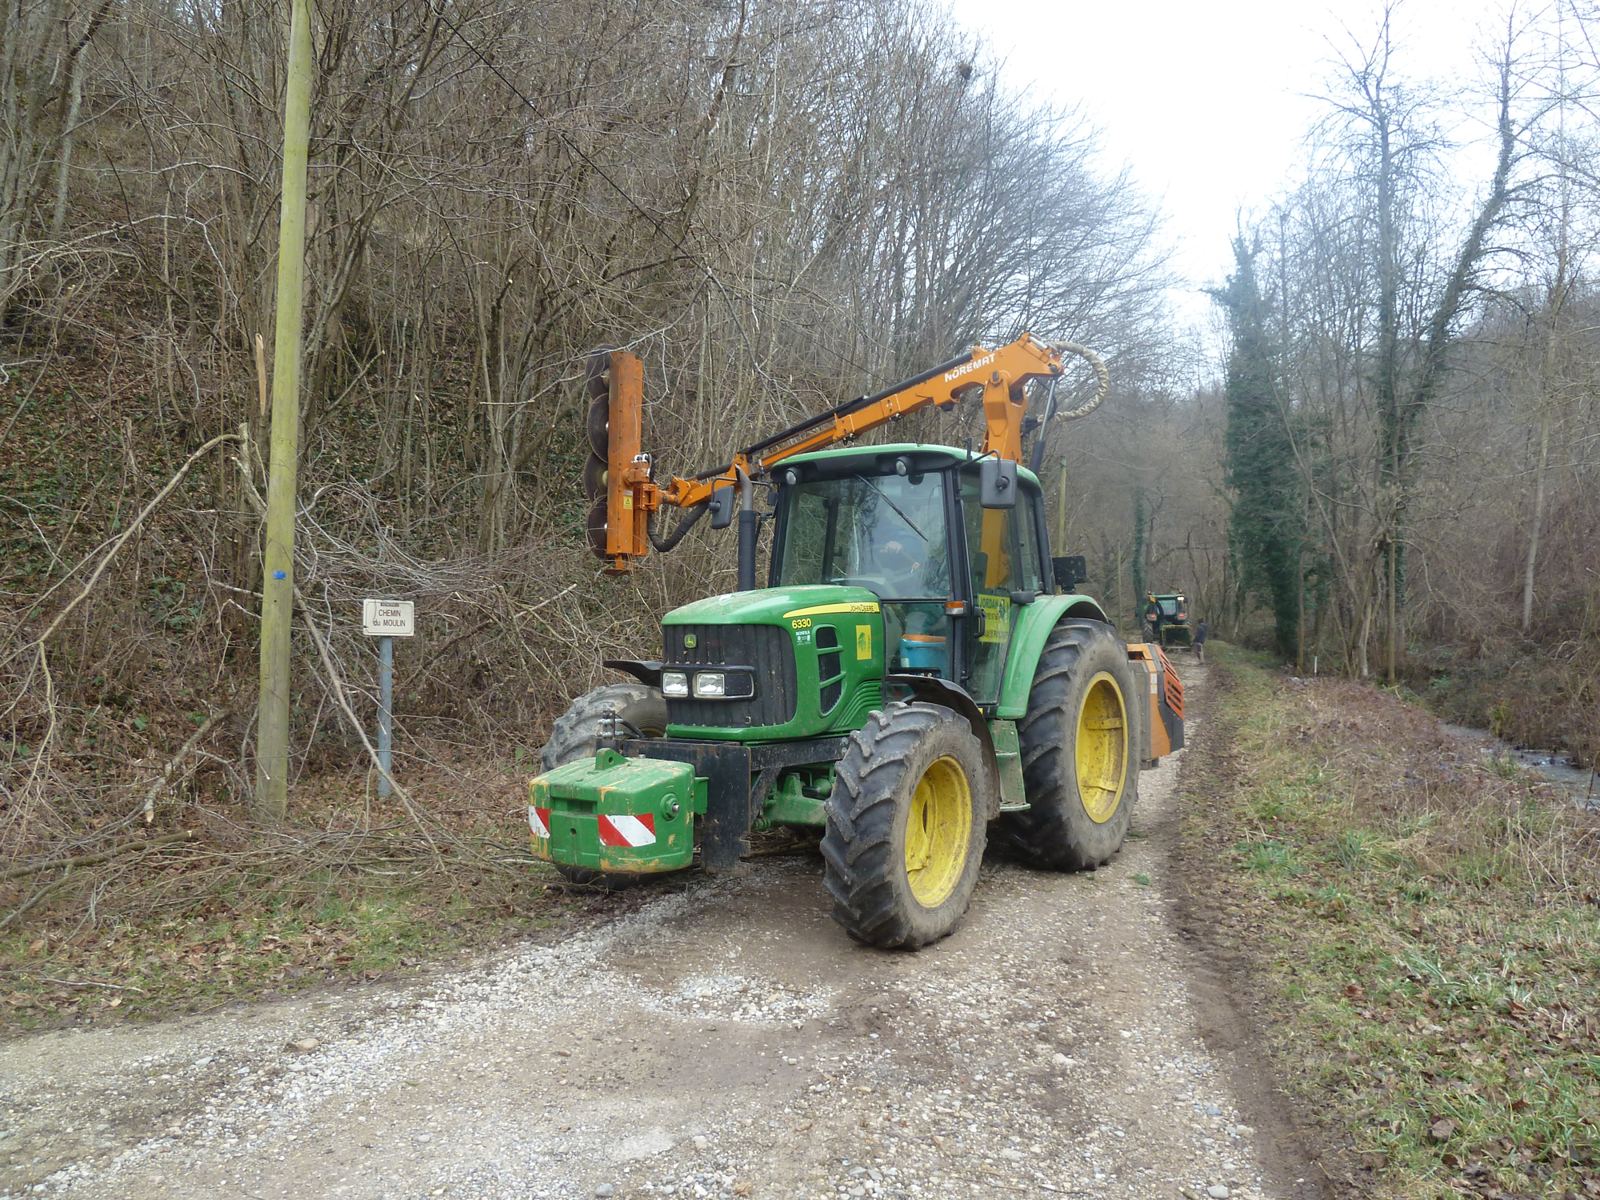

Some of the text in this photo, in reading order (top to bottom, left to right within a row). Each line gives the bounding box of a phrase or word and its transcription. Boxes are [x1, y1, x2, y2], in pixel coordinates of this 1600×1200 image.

[944, 353, 996, 383] NOREMAT
[378, 609, 401, 617] CHEMIN
[383, 619, 406, 627] MOULIN
[792, 618, 811, 629] 6330
